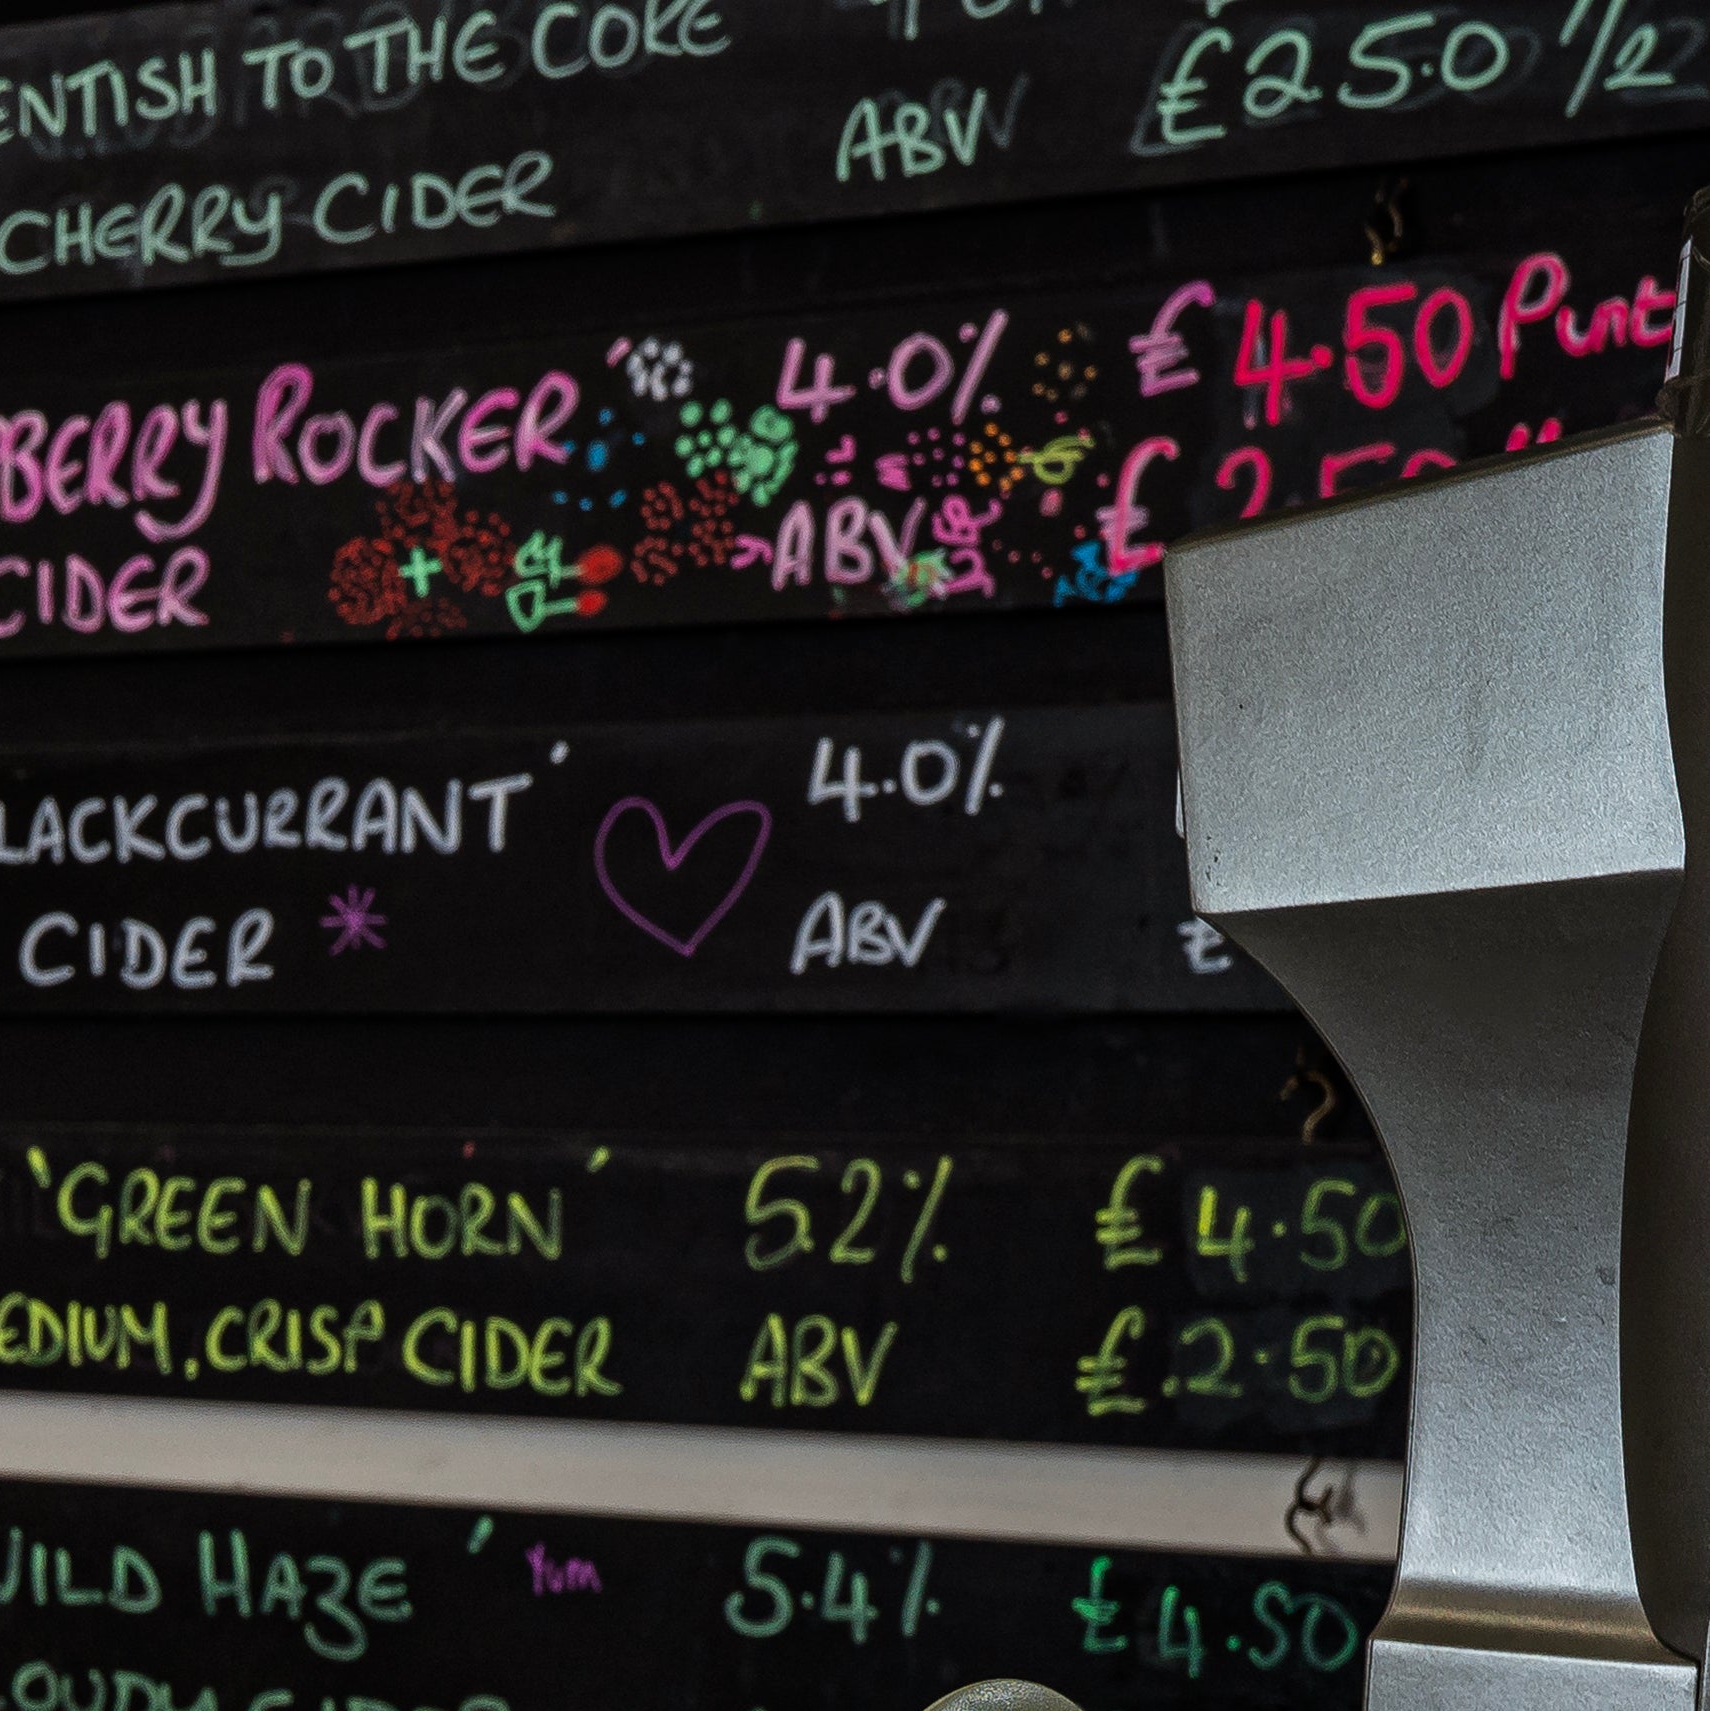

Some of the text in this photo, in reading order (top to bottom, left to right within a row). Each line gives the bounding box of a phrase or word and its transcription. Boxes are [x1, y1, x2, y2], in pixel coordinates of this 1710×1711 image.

[243, 39, 334, 110] TO
[343, 8, 506, 94] THE
[530, 0, 733, 79] CORE
[836, 87, 988, 182] ABV
[312, 150, 557, 245] CIDER
[807, 714, 1006, 824] 4.0%
[17, 906, 277, 991] CIDER
[788, 890, 948, 976] ABV
[402, 1306, 624, 1397] CIDER
[738, 1312, 899, 1409] ABV
[723, 1534, 942, 1647] 5.4%
[1071, 1555, 1361, 1680] £4.50
